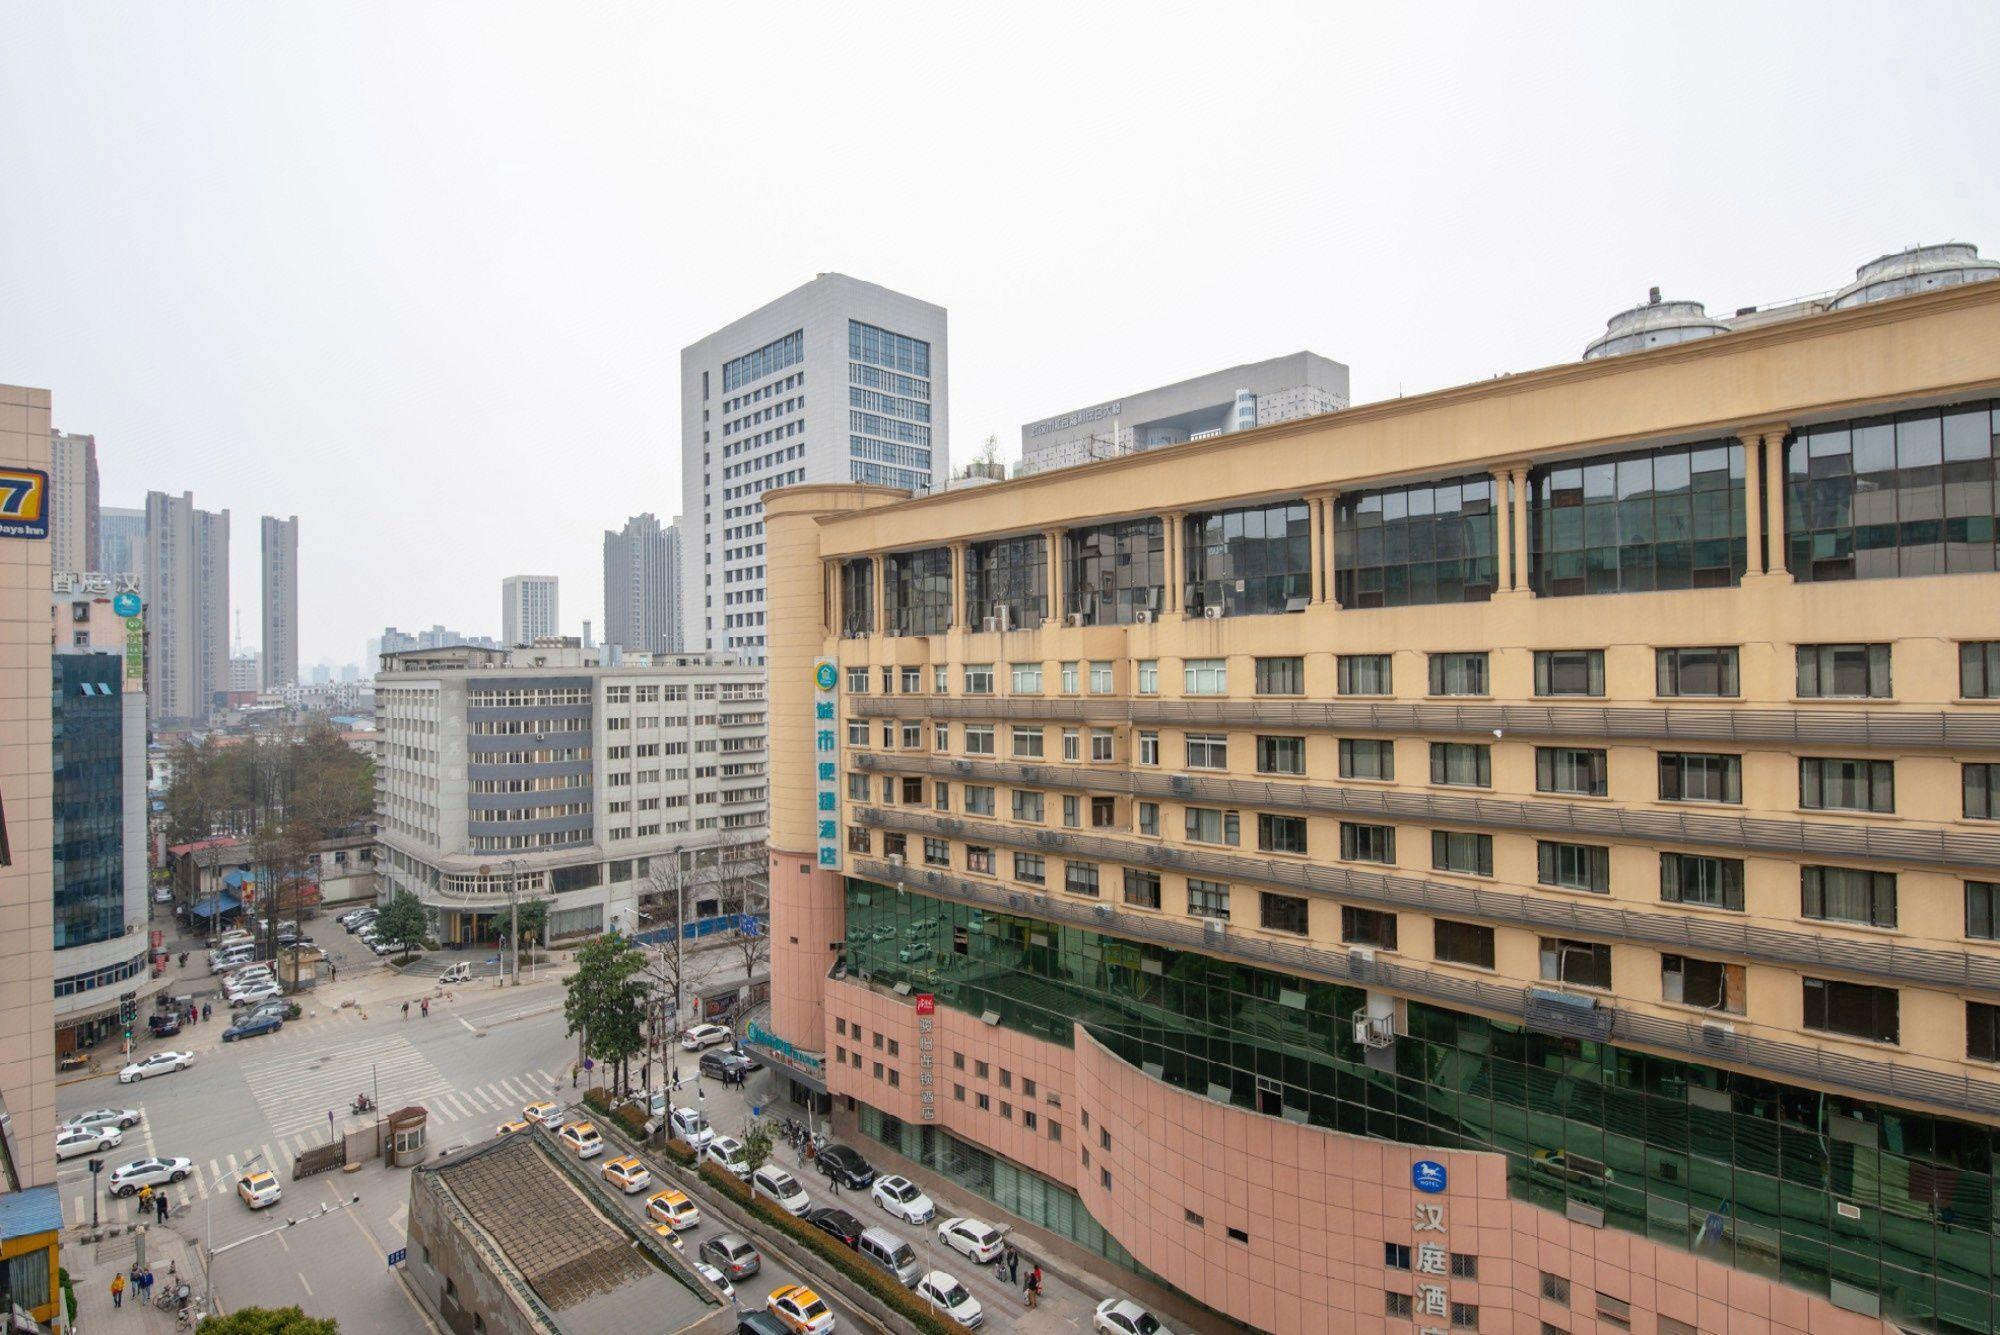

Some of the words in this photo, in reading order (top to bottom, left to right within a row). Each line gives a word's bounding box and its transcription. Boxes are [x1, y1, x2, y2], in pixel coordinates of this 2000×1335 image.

[0, 477, 35, 514] 7
[815, 700, 837, 866] 城市便捷酒店
[918, 1017, 935, 1121] 骏怡连锁酒店
[1419, 1179, 1440, 1188] HOTEL
